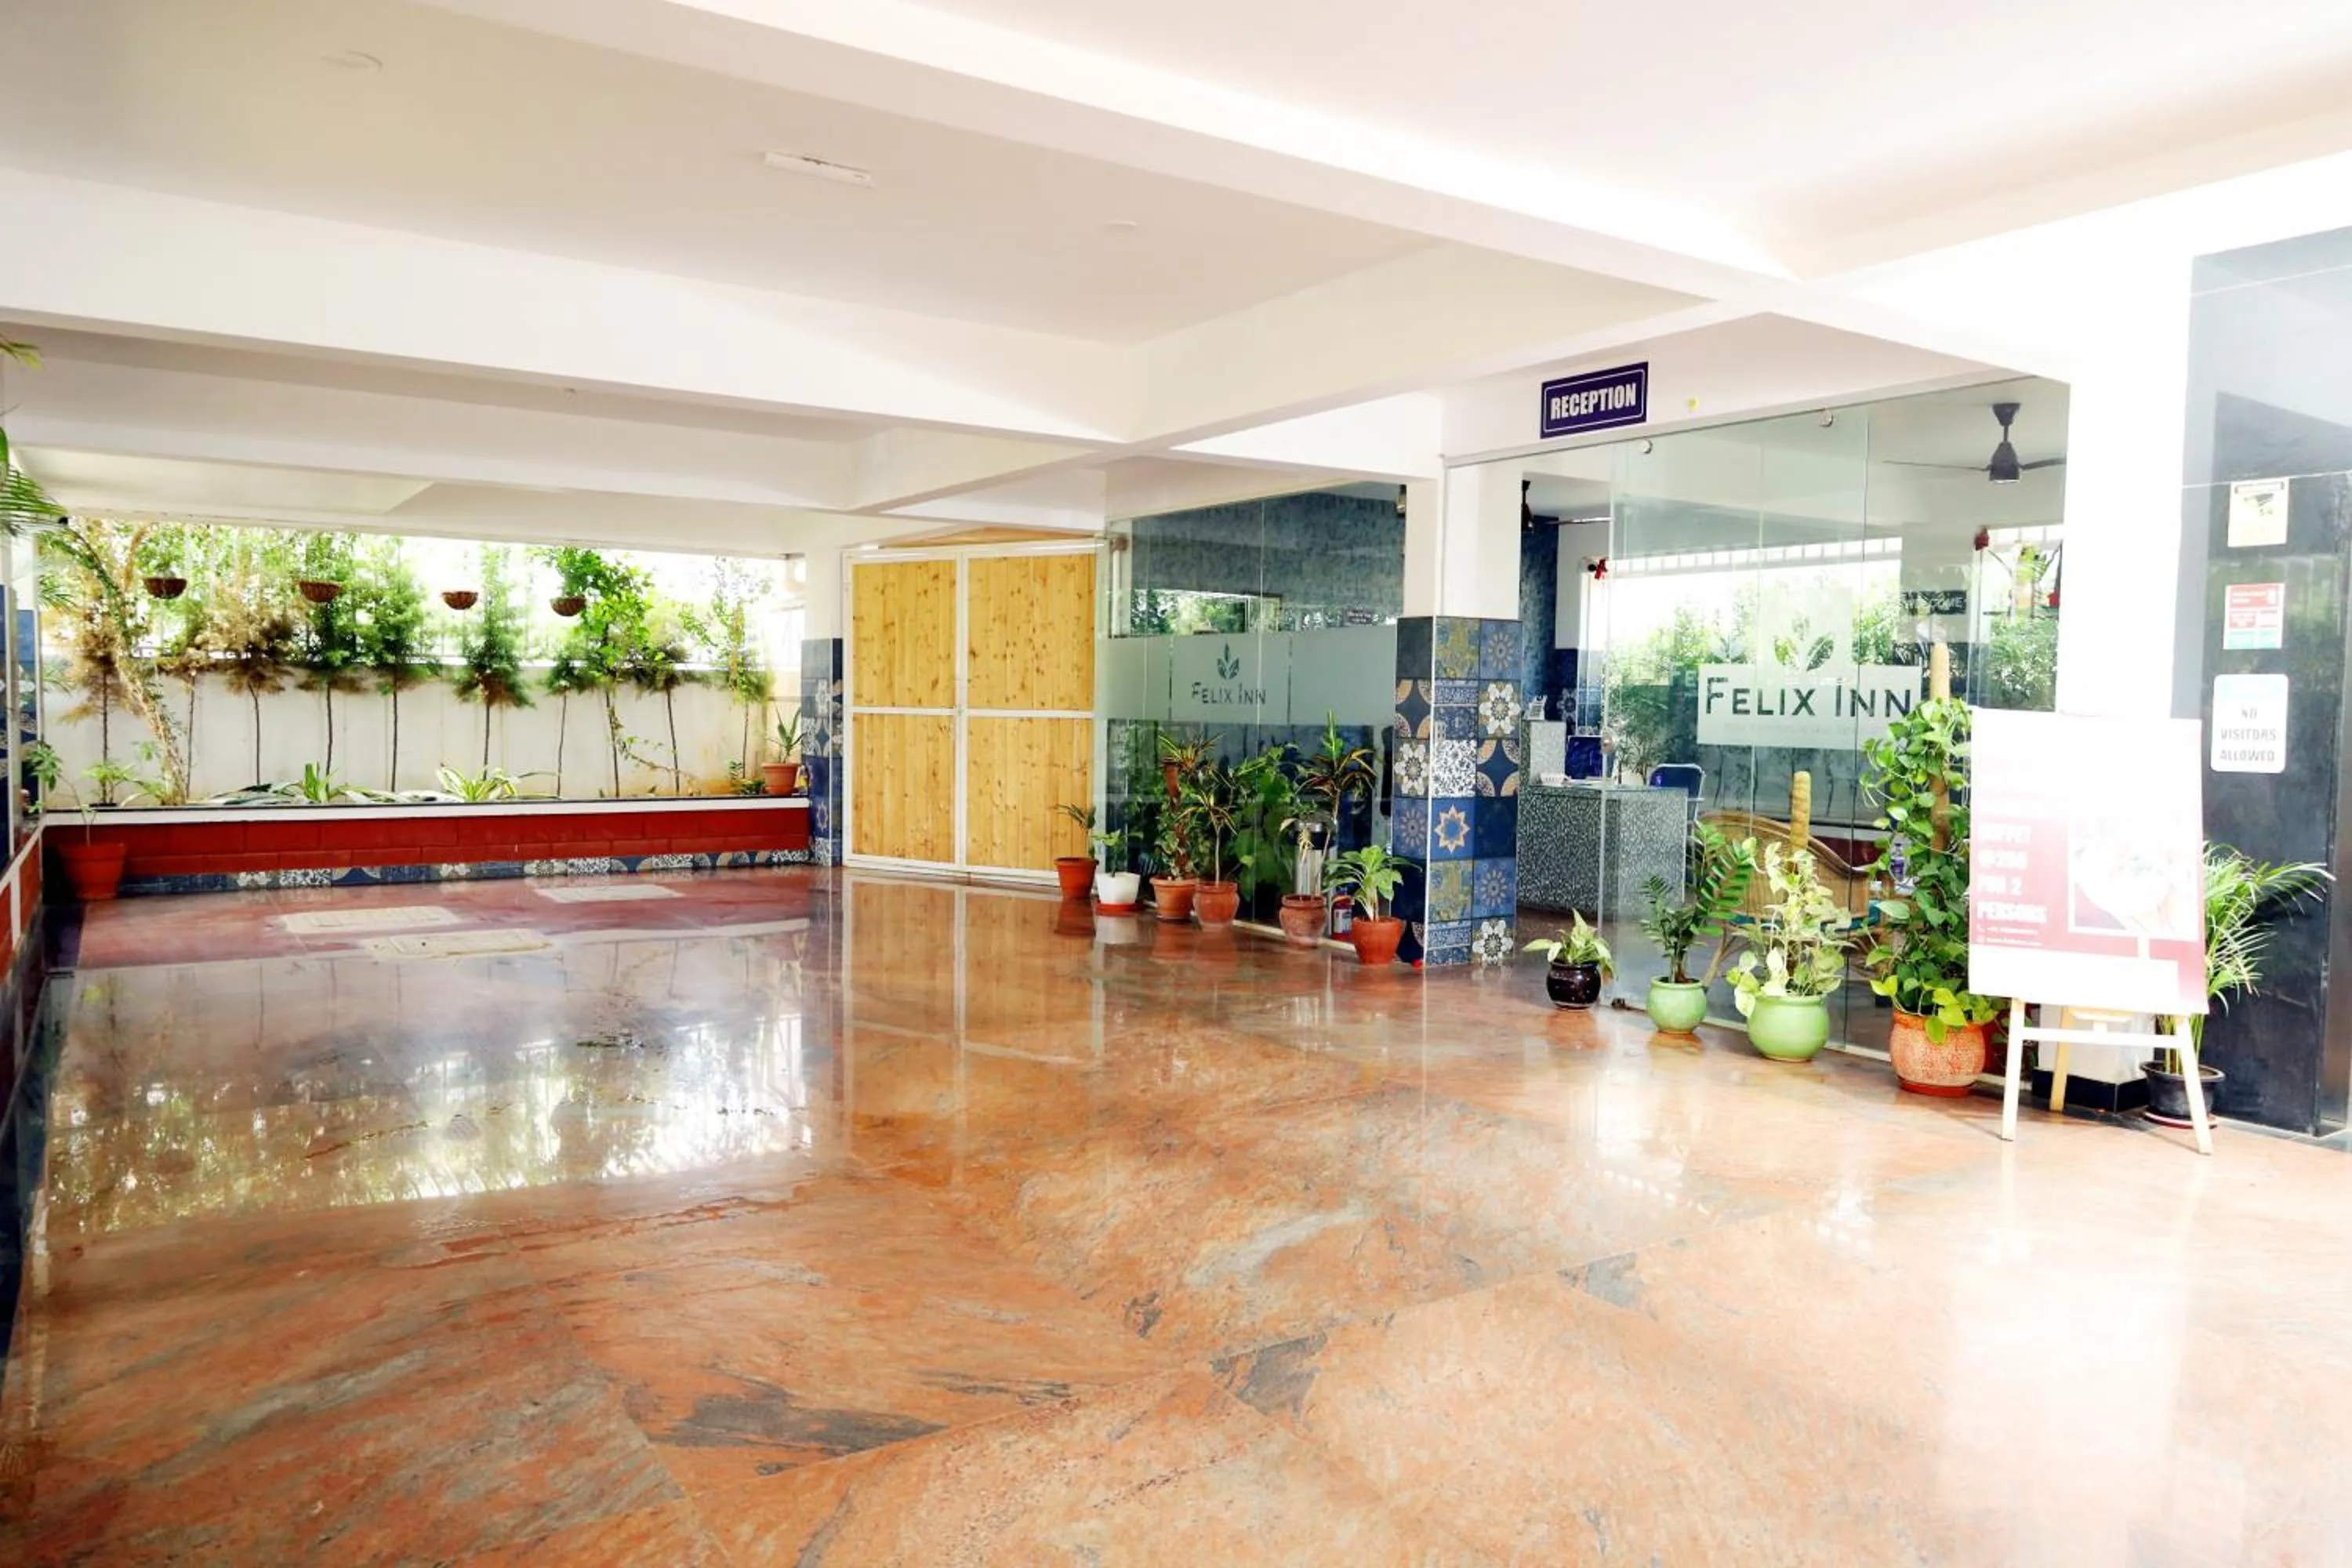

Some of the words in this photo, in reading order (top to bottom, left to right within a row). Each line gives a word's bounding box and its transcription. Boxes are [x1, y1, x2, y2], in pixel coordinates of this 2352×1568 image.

[1551, 383, 1636, 419] RECEPTION
[1192, 681, 1232, 704] FELIX
[1238, 682, 1266, 704] INN
[1706, 677, 1816, 716] FELIX
[1835, 678, 1911, 717] INN
[2241, 706, 2257, 720] NO
[2220, 728, 2277, 742] VISITORS
[2220, 749, 2275, 762] ALLOWED
[2012, 877, 2022, 894] 2
